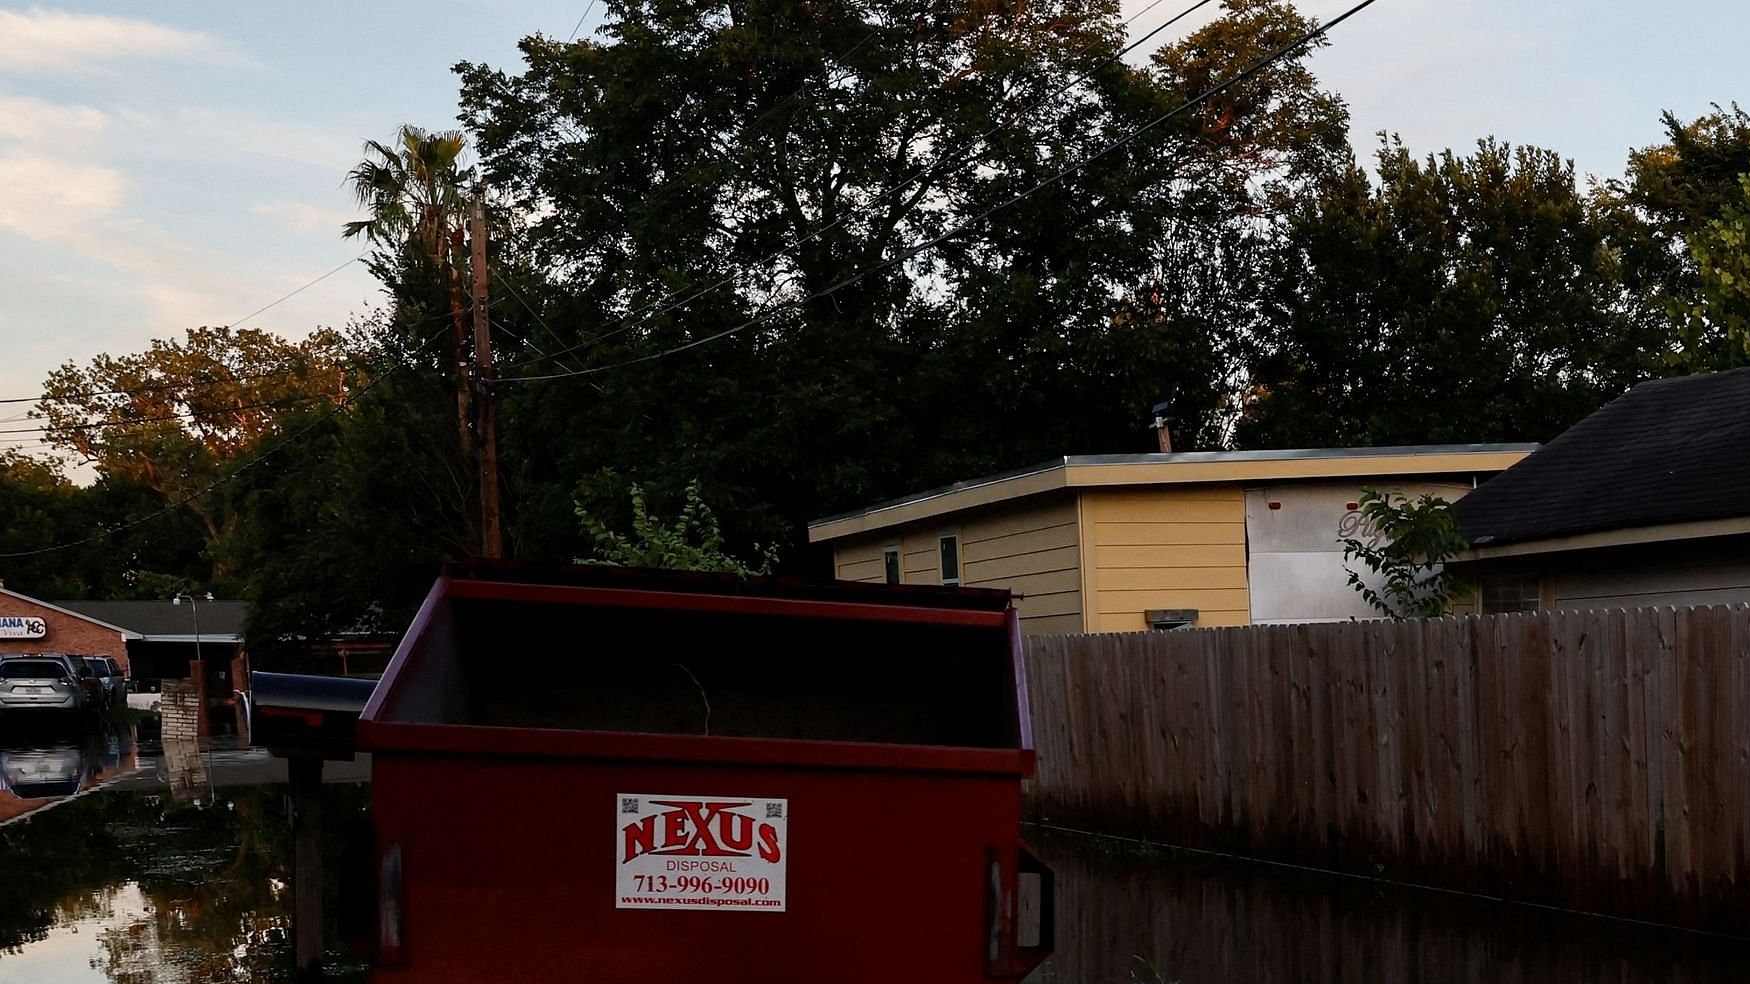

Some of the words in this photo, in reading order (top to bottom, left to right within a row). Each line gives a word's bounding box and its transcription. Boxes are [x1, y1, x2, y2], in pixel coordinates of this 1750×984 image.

[0, 618, 24, 628] ANA
[622, 800, 782, 864] NEXUS
[666, 860, 737, 873] DISPOSAL
[633, 875, 770, 895] 713-996-9090
[621, 895, 781, 907] www.nexusdisposal.com
